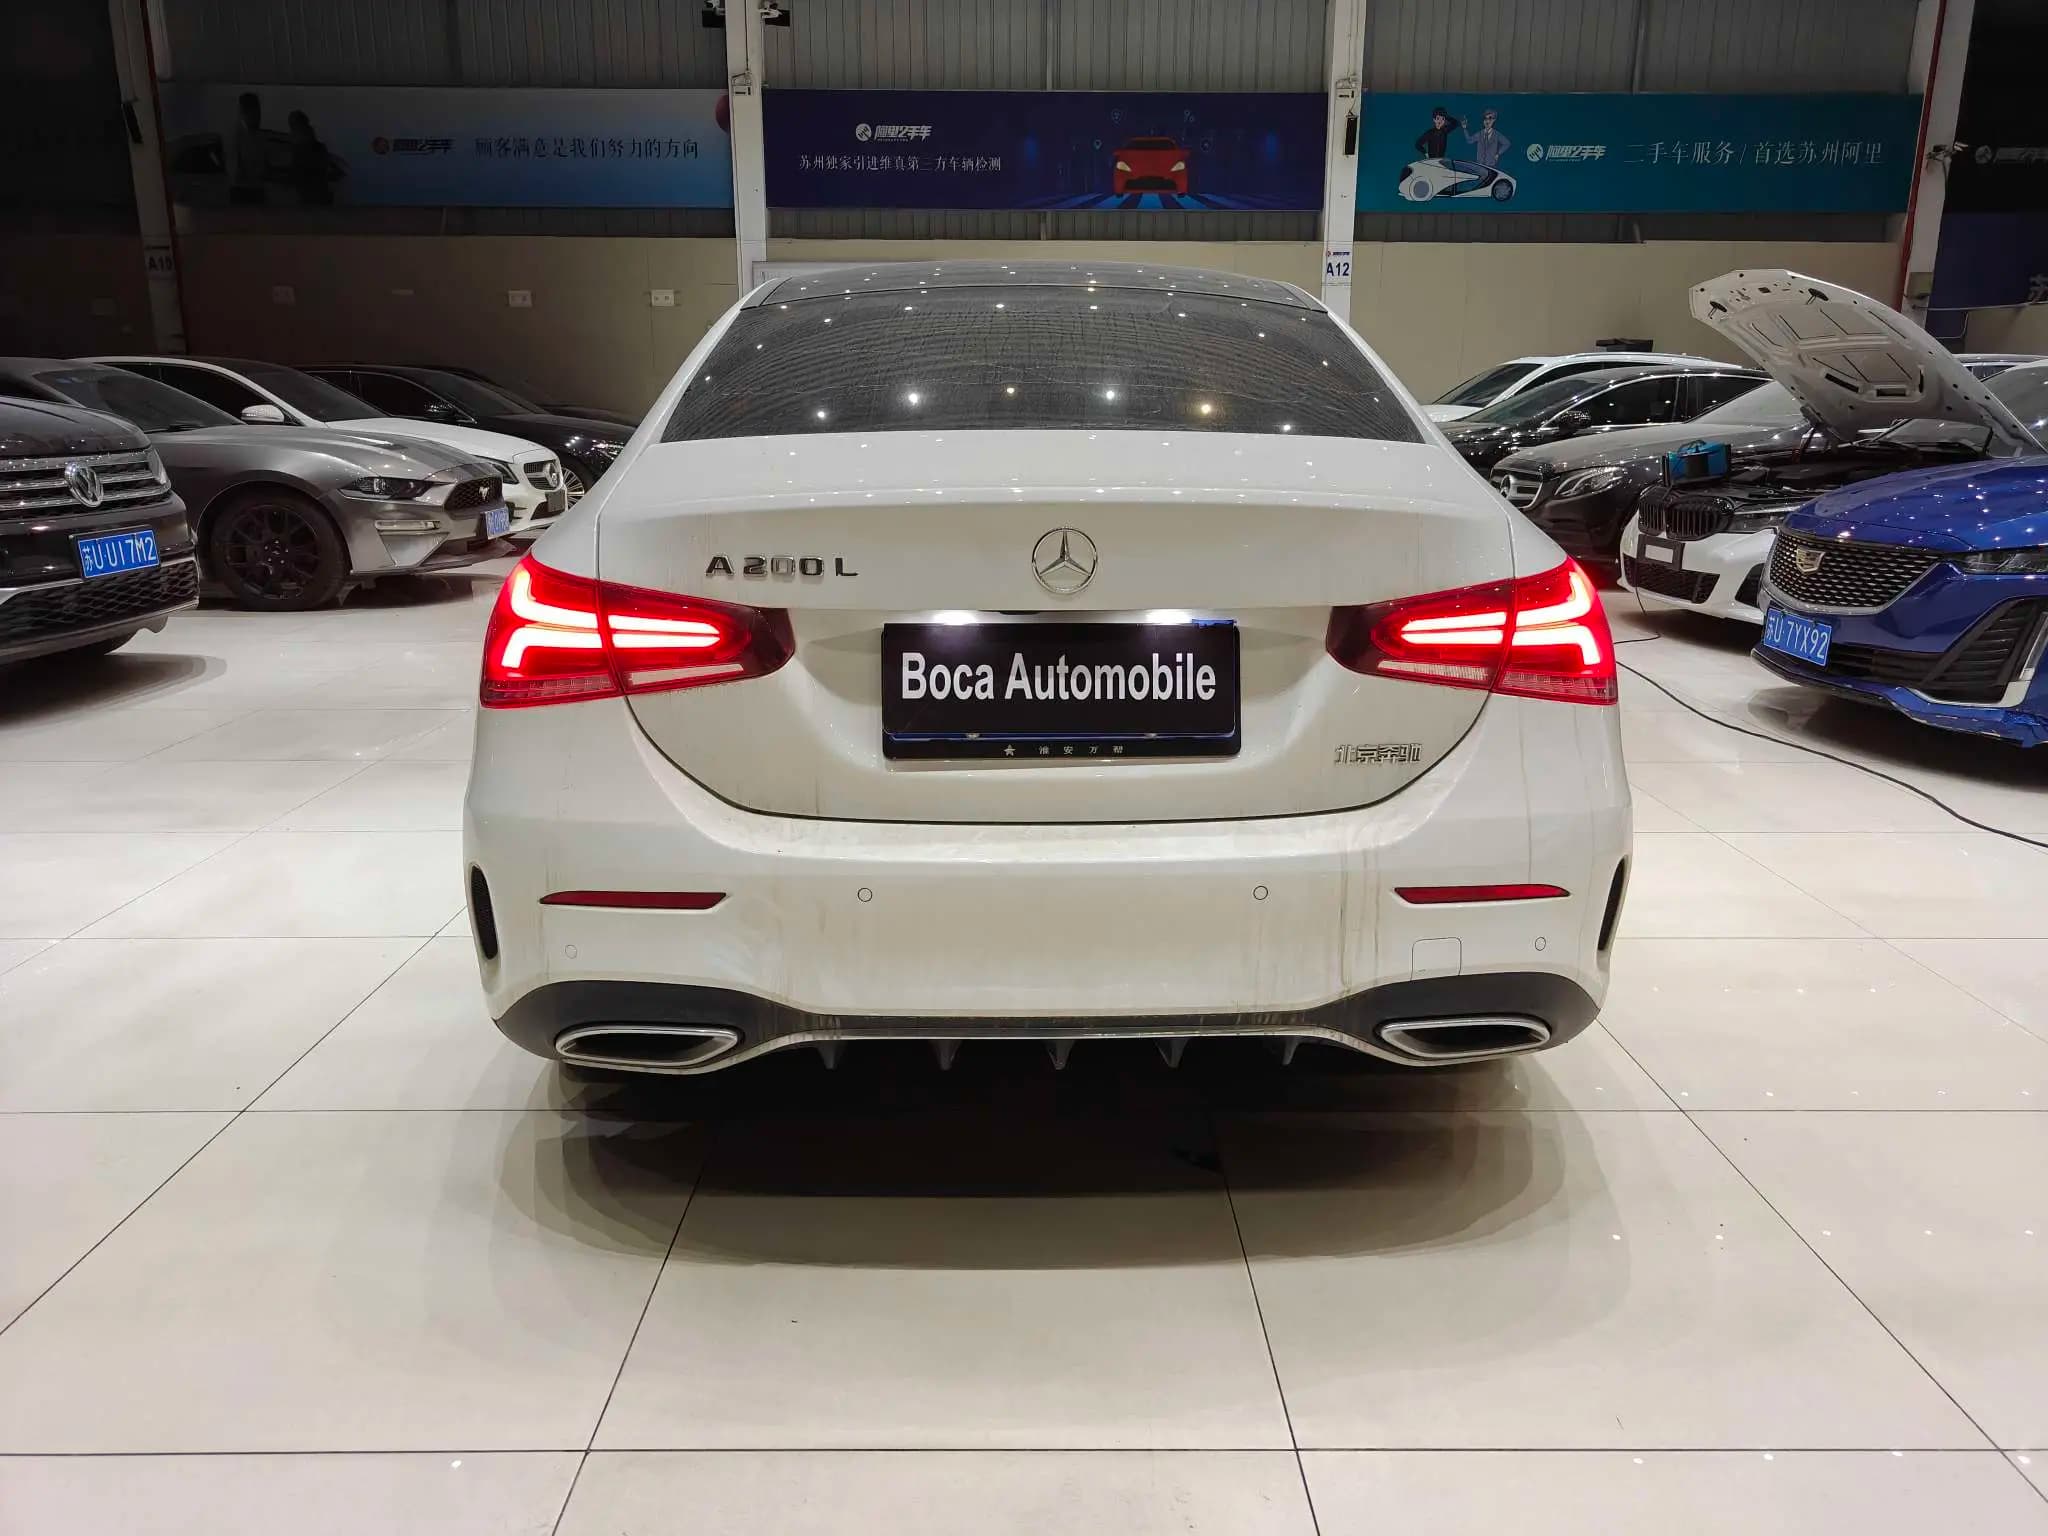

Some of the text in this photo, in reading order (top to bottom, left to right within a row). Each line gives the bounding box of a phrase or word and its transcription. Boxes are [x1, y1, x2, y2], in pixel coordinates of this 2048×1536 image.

[474, 138, 699, 160] 顾客满意是我们努力的方向
[1624, 140, 1735, 165] 二手车服务
[1753, 140, 1882, 165] 首选苏州阿里
[799, 154, 1001, 171] 苏州独家引进维真第三方车辆检测
[148, 256, 173, 271] A10
[1326, 261, 1350, 277] A12
[705, 555, 735, 577] A
[834, 556, 859, 577] L
[1334, 743, 1422, 765] 北京奔驰
